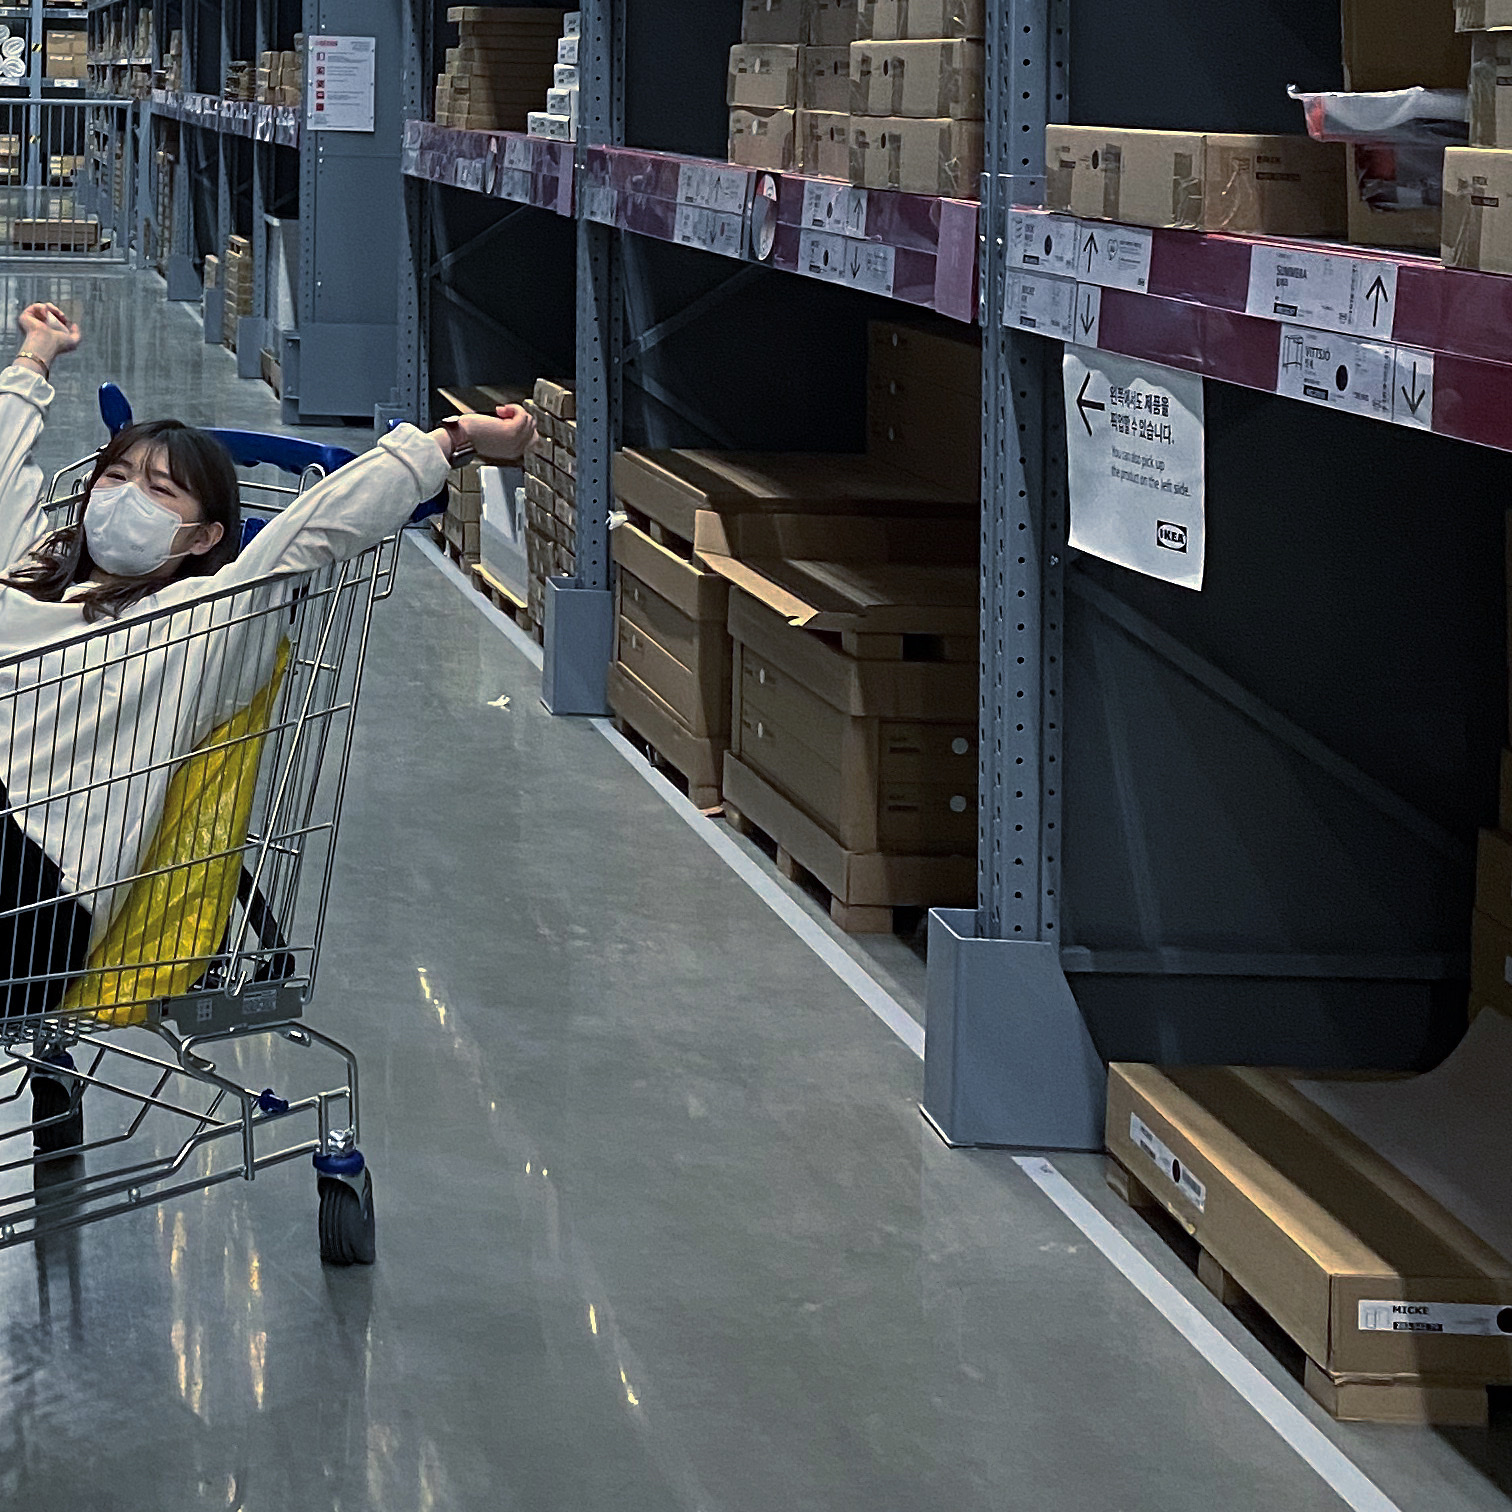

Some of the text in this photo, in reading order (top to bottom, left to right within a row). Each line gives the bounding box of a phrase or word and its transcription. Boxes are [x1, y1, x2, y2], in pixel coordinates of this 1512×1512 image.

[1144, 393, 1170, 418] 제품을
[1159, 528, 1185, 547] IKEA
[1392, 1305, 1429, 1316] MICKE
